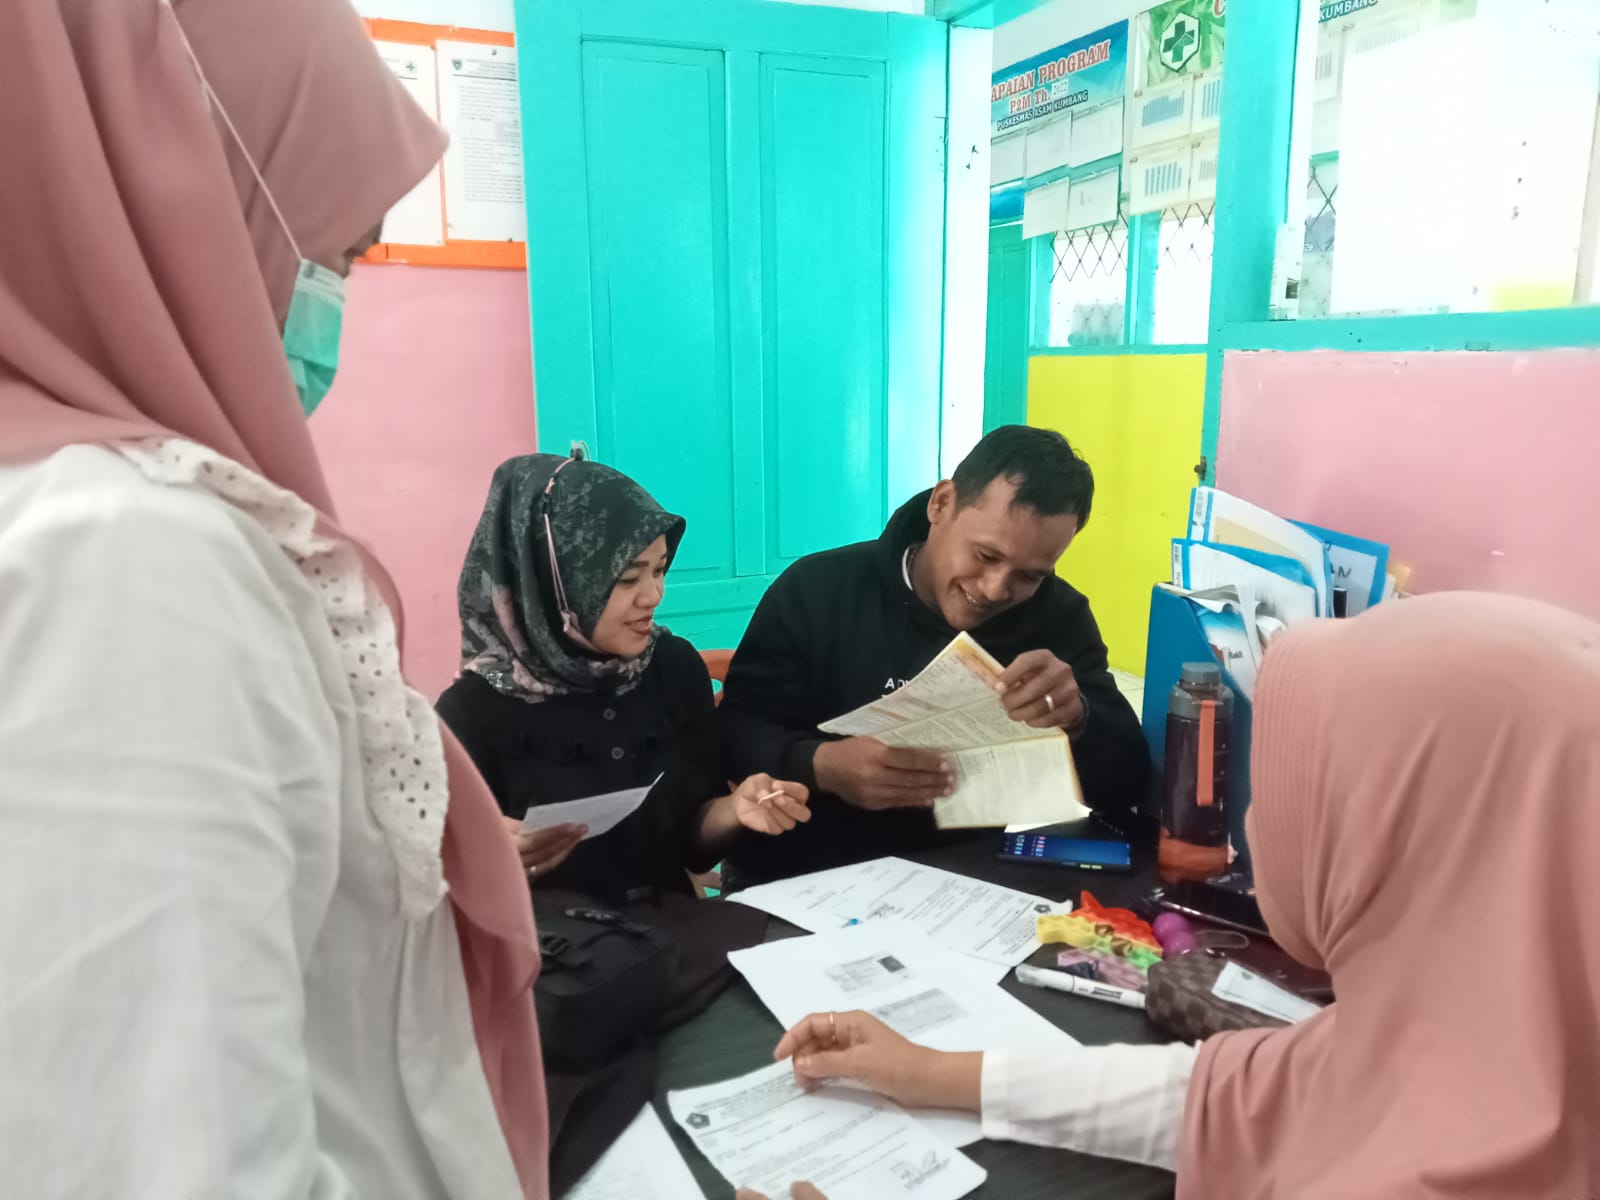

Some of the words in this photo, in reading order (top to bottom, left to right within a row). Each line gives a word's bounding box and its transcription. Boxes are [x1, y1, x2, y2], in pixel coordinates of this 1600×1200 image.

[1038, 40, 1111, 84] PROGRAM
[997, 109, 1033, 131] PUSKESMAS
[1033, 103, 1052, 119] ASAM
[1053, 90, 1088, 112] KUMBANG
[1009, 92, 1031, 113] P2M
